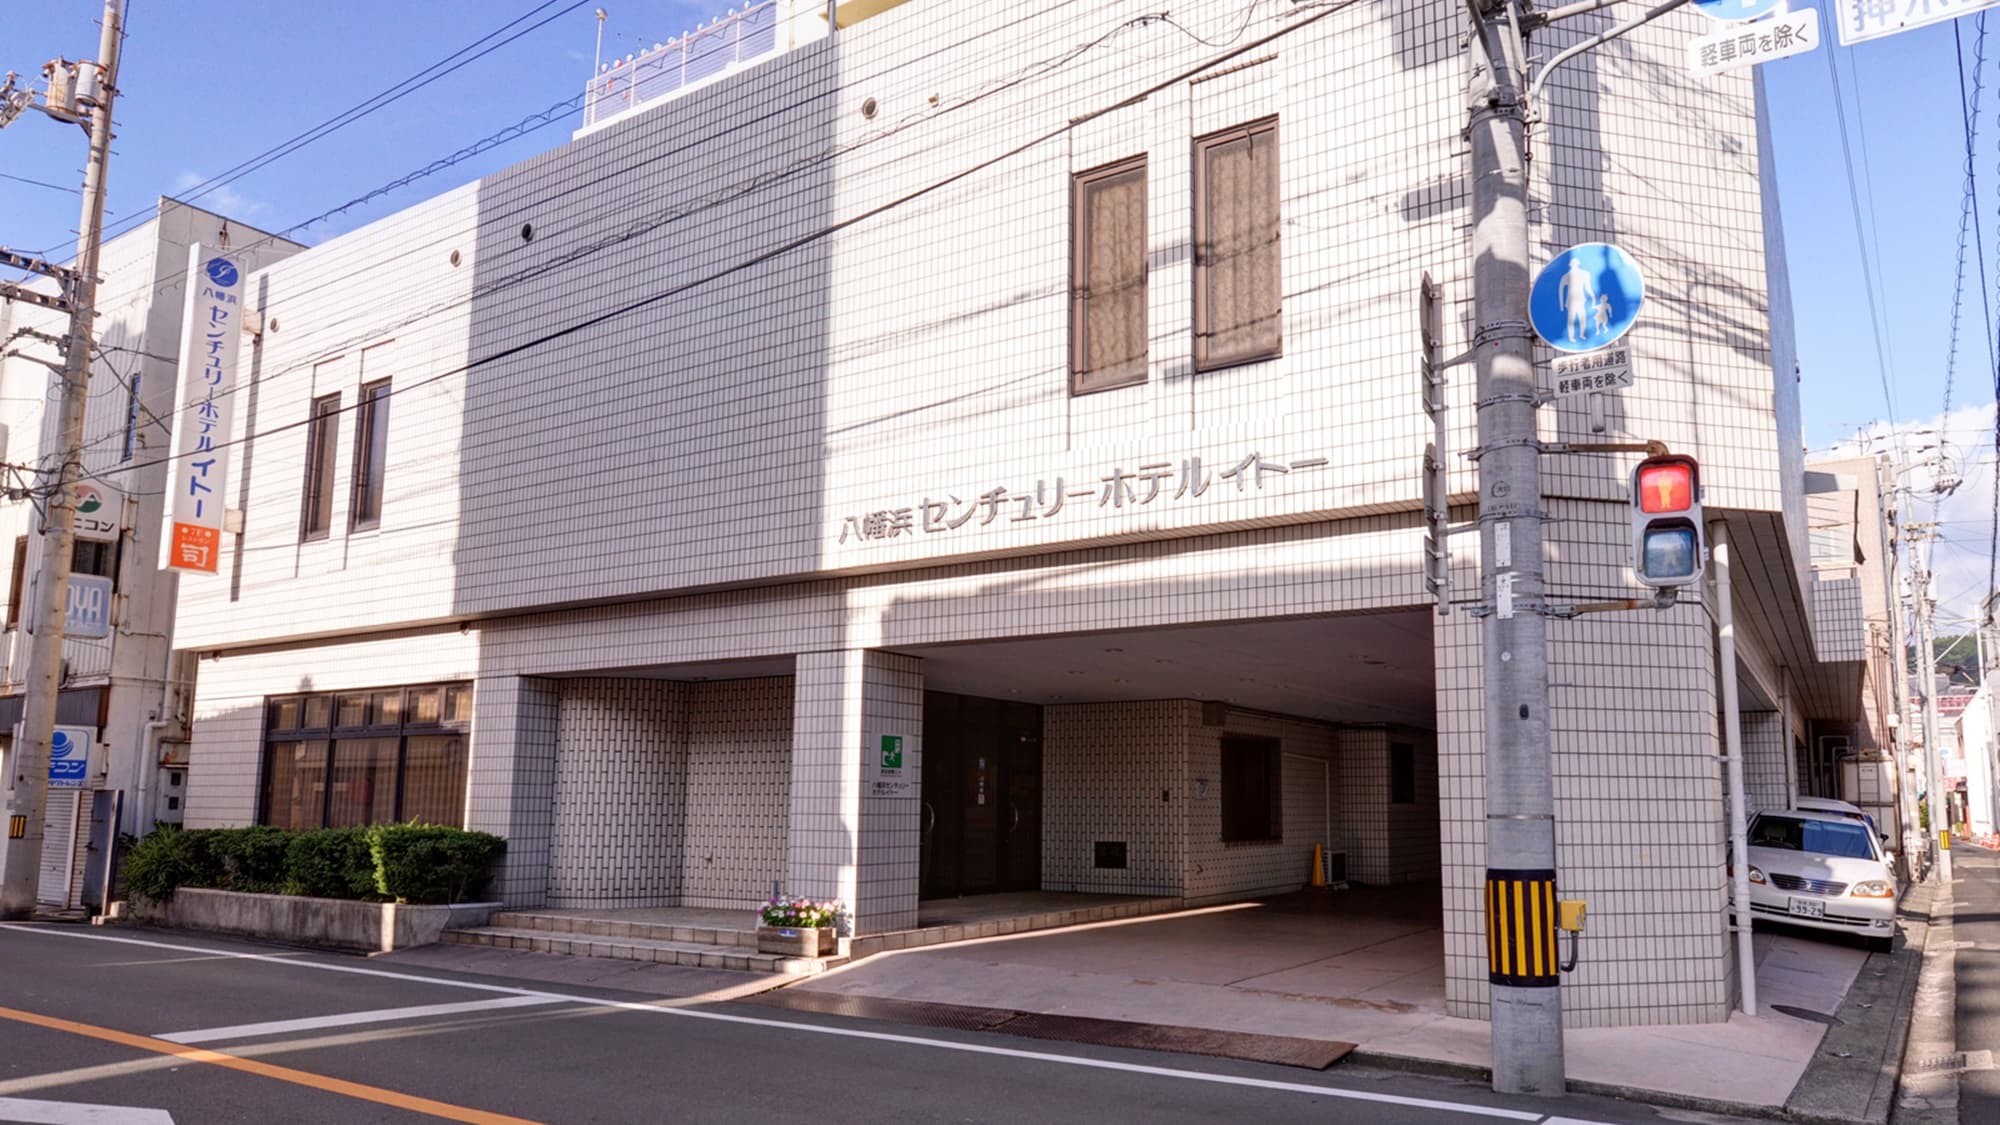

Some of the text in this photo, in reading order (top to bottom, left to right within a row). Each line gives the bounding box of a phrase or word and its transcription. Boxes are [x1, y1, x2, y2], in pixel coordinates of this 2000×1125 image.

[1700, 23, 1808, 68] 軽車両を除く
[202, 287, 237, 305] 八幡浜
[1558, 350, 1626, 375] 歩行者用道路
[1559, 369, 1628, 394] 軽車両を除く
[180, 542, 209, 568] 司
